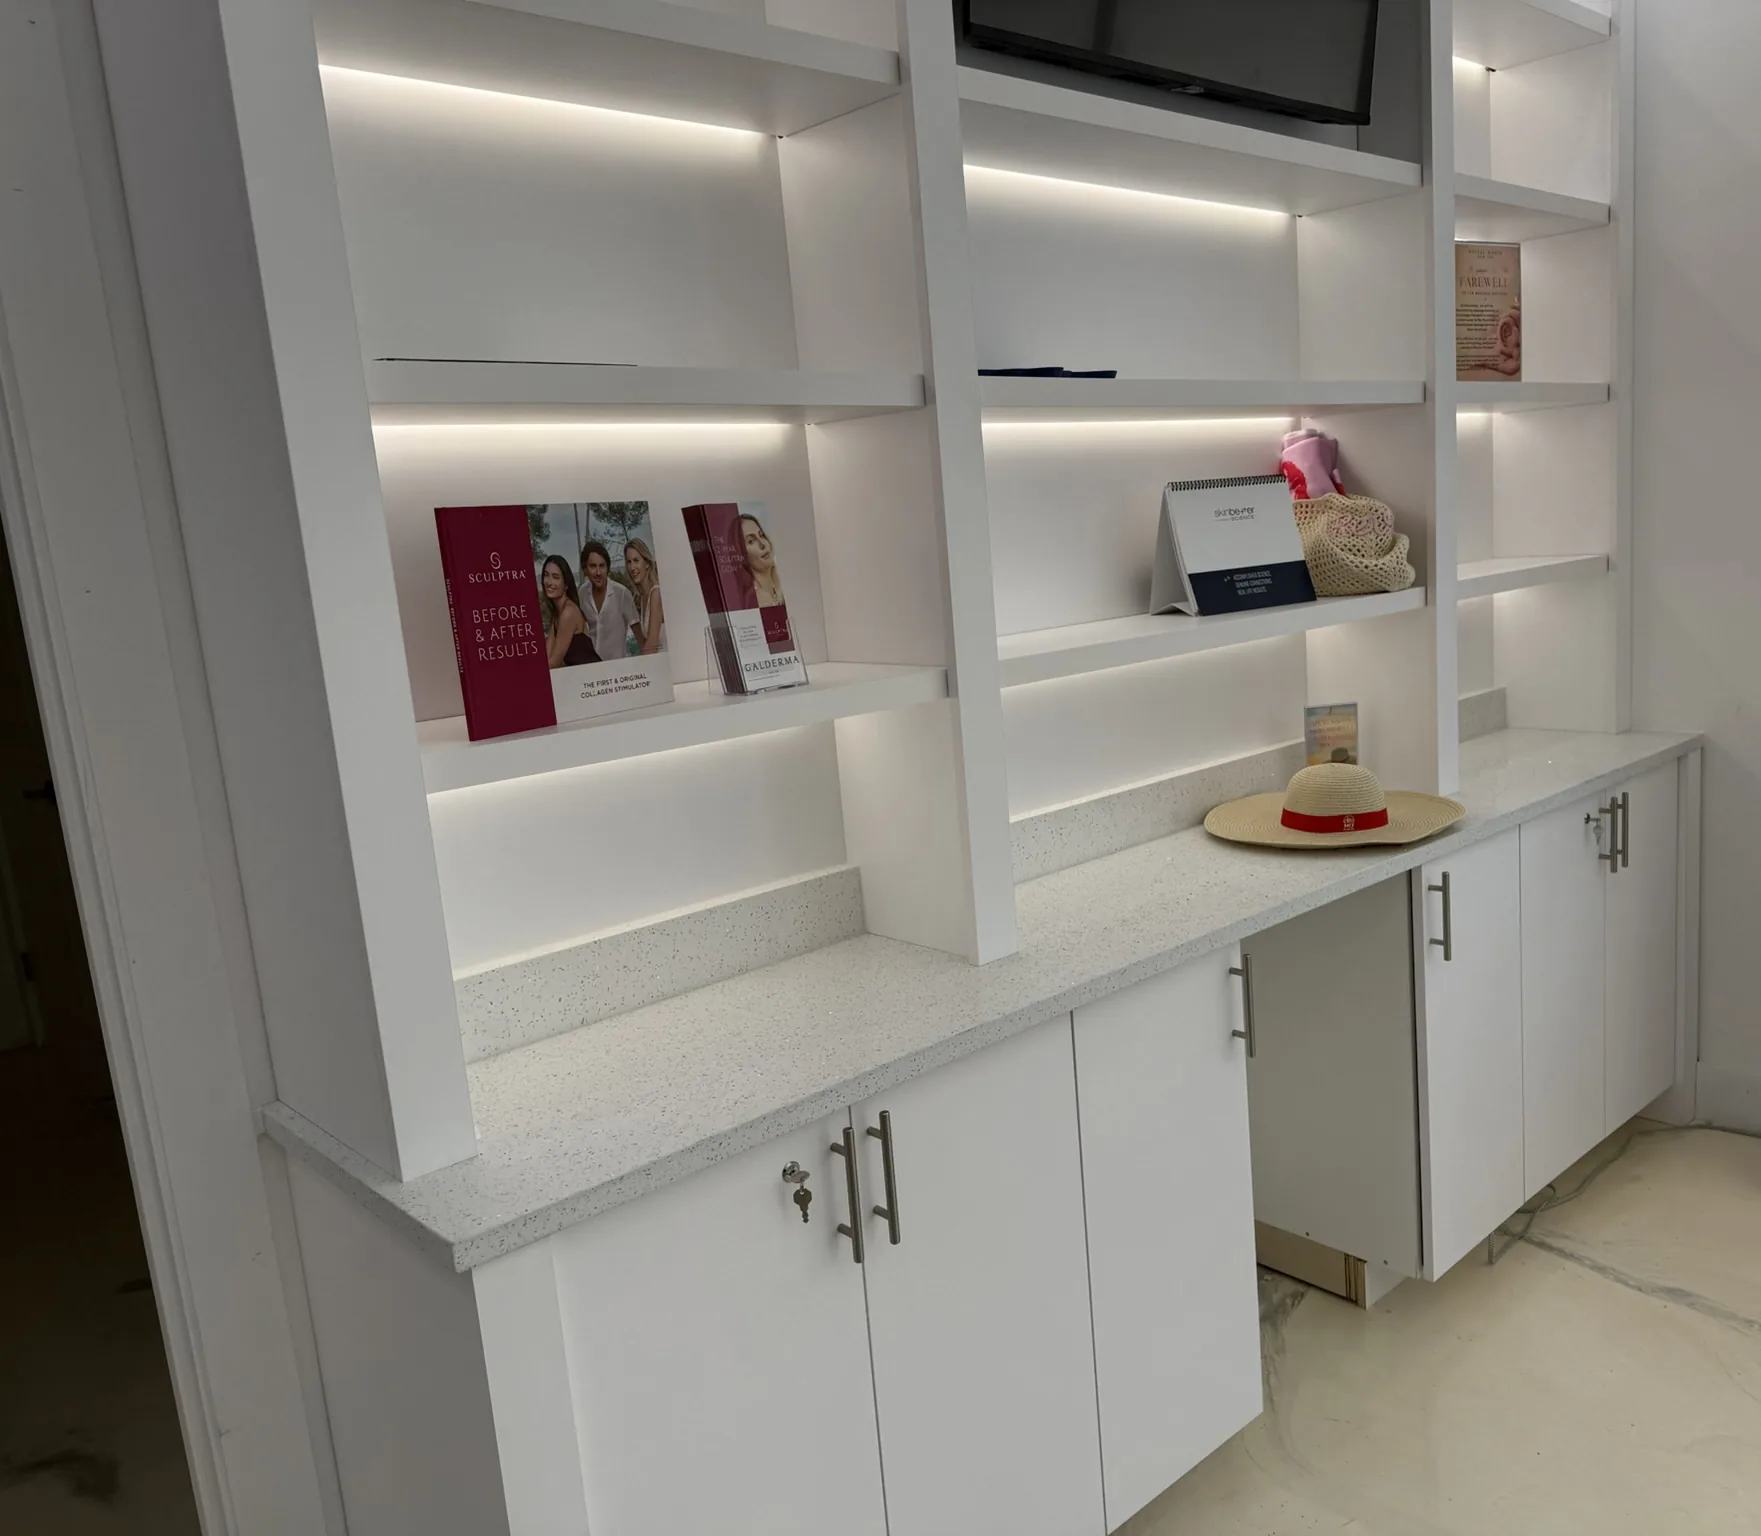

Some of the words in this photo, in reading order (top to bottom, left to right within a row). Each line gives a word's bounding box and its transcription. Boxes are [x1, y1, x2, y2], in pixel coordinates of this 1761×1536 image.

[1459, 275, 1508, 288] FAREWELL
[468, 569, 527, 583] SCULPTRA
[472, 604, 528, 624] BEFORE
[476, 629, 485, 643] &
[490, 623, 535, 641] AFTER
[478, 640, 539, 662] RESULTS
[744, 655, 800, 672] GALDERMA
[580, 687, 613, 699] COLLAGEN
[614, 680, 651, 693] STIMULATOR
[583, 681, 595, 689] THE
[596, 678, 613, 687] FIRST
[619, 673, 647, 683] ORIGINAL
